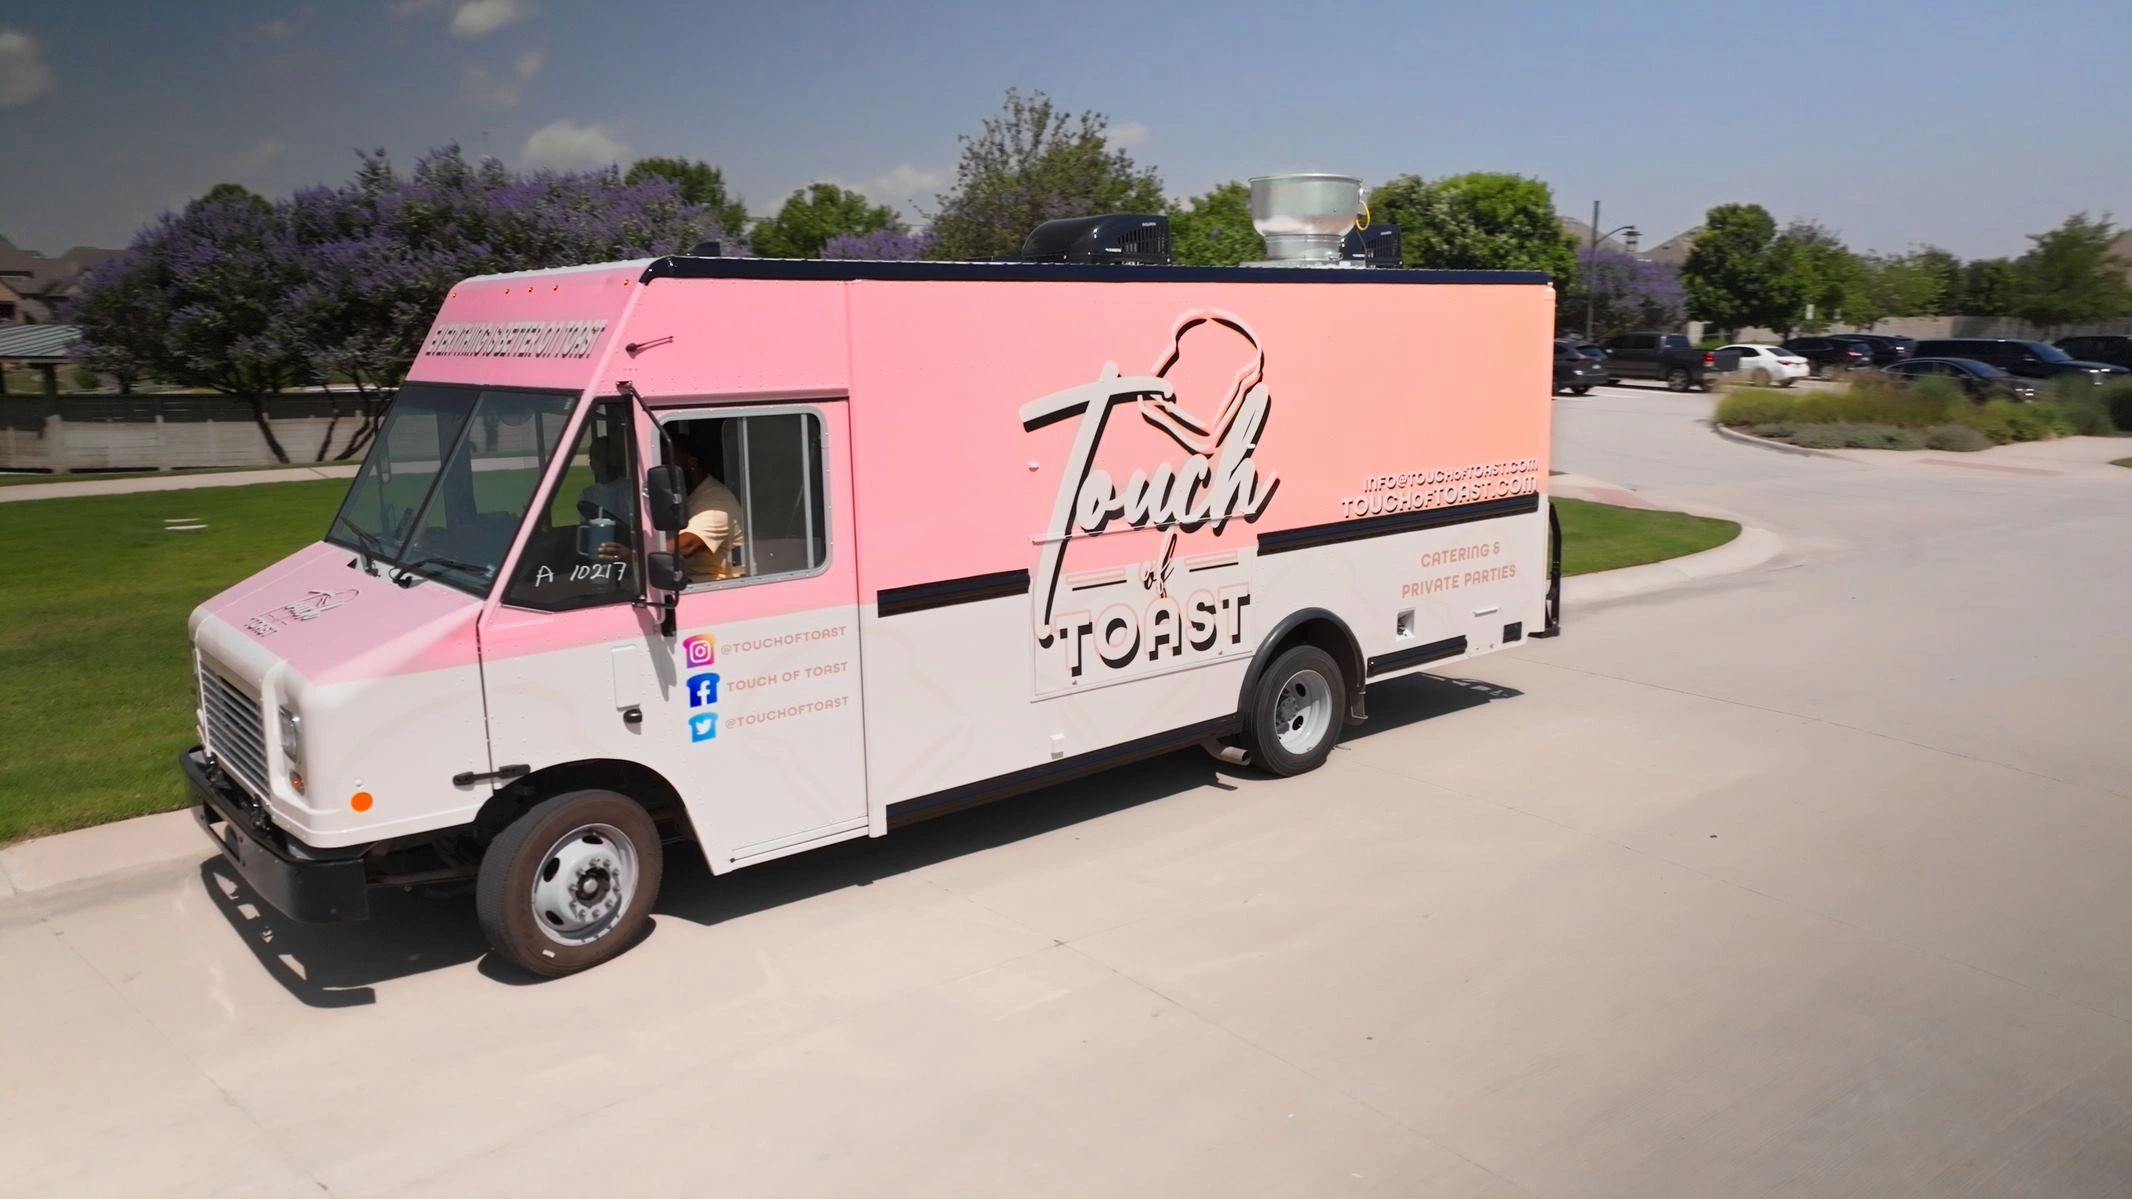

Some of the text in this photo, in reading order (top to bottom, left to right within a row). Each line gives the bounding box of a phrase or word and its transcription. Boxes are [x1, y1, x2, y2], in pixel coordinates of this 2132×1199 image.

[1019, 360, 1280, 649] Touch
[1421, 541, 1500, 568] CATERING &
[535, 562, 627, 587] A 10217
[1402, 564, 1516, 599] PRIVATE PARTIES
[720, 626, 847, 656] @TOUCHOFTOAST
[1055, 582, 1250, 678] TOAST
[727, 661, 848, 692] TOUCH OF TOAST
[725, 696, 849, 730] @TOUCHOFTOAST
